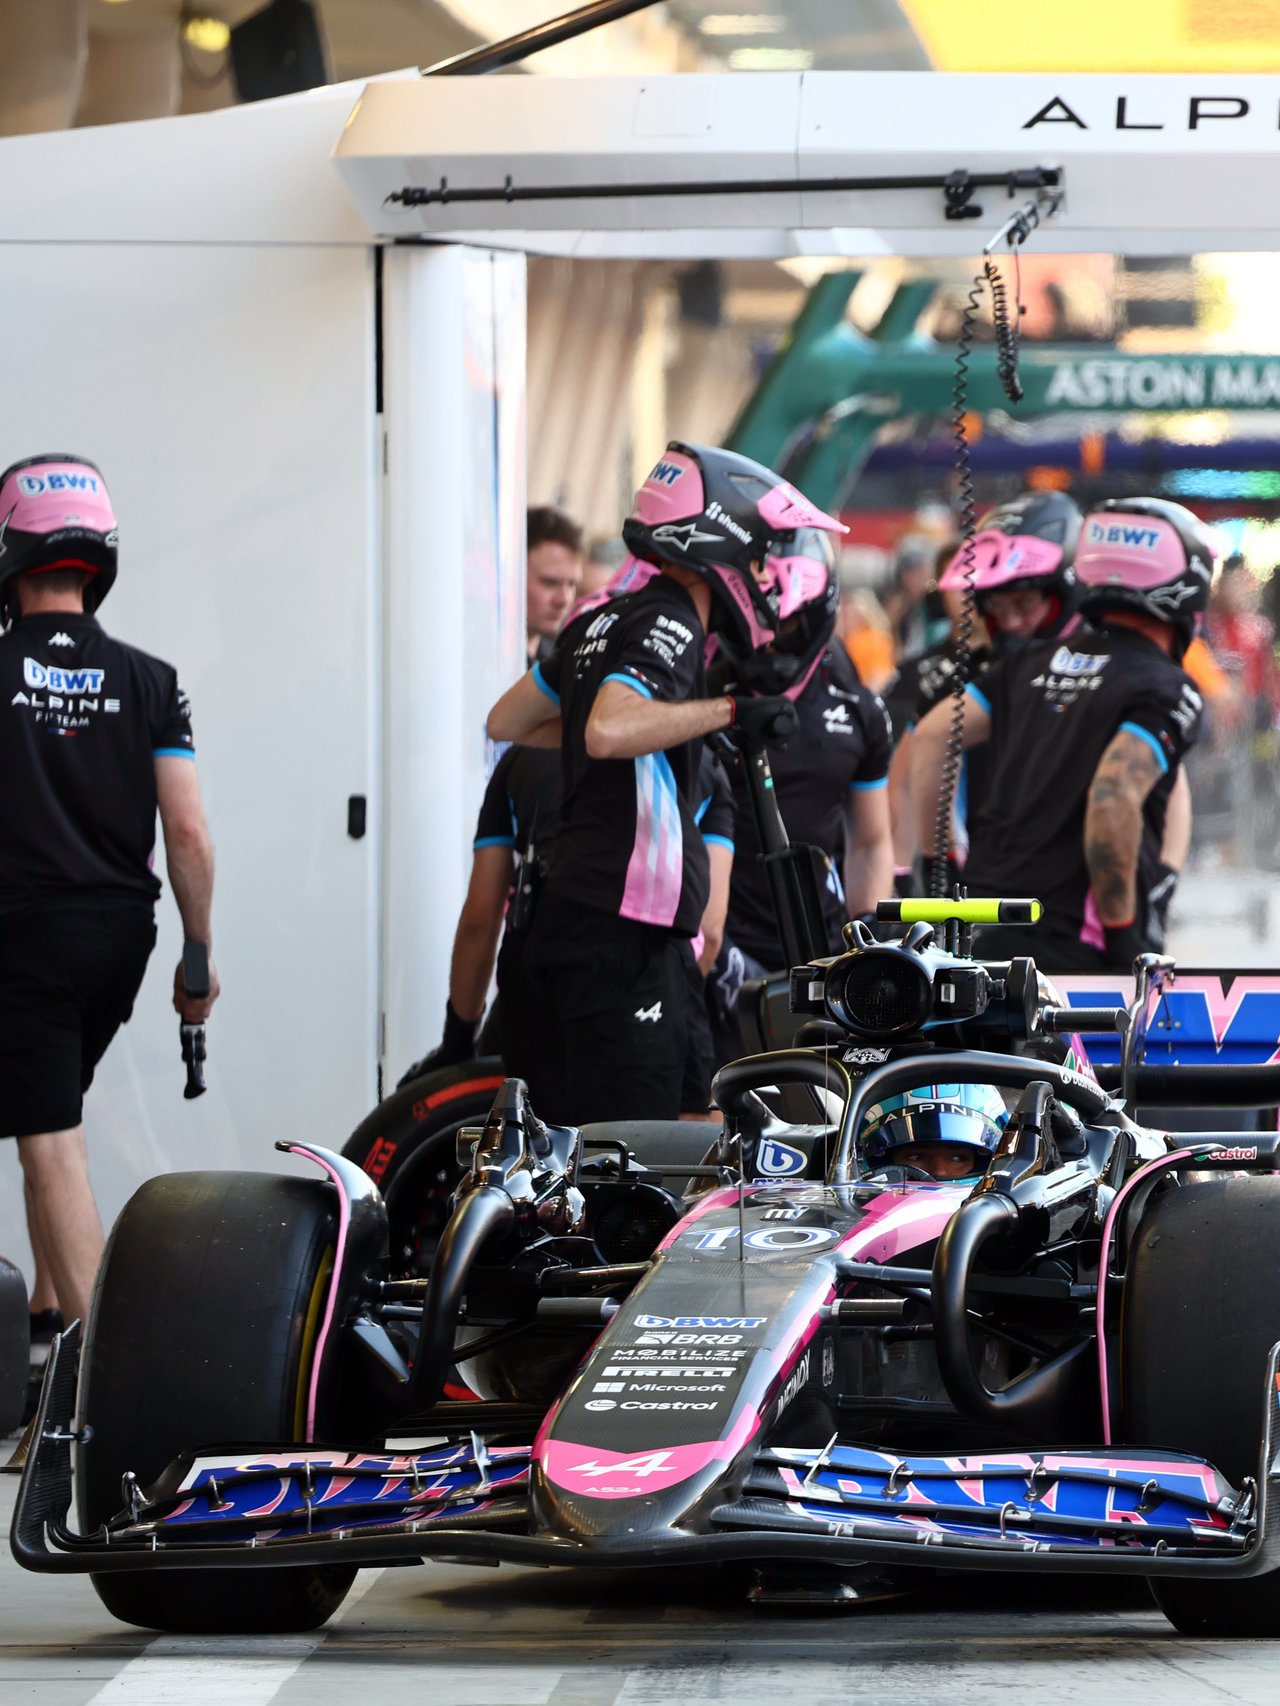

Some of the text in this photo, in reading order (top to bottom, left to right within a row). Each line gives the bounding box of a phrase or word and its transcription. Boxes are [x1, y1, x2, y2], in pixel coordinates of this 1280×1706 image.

[1046, 360, 1204, 406] ASTON
[47, 472, 99, 494] BWT
[717, 511, 753, 545] shamir
[1107, 525, 1161, 550] BWT
[48, 667, 104, 694] BWT
[12, 691, 121, 713] ALPINE
[57, 713, 90, 728] TEAM
[884, 1103, 985, 1125] ALPINE
[1209, 1146, 1257, 1160] Castrol
[686, 1226, 841, 1250] 10
[671, 1317, 768, 1328] BWT
[671, 1334, 744, 1345] BRB
[601, 1366, 737, 1378] PIRELLI
[629, 1383, 727, 1393] Microsoft
[619, 1401, 719, 1411] Castrol
